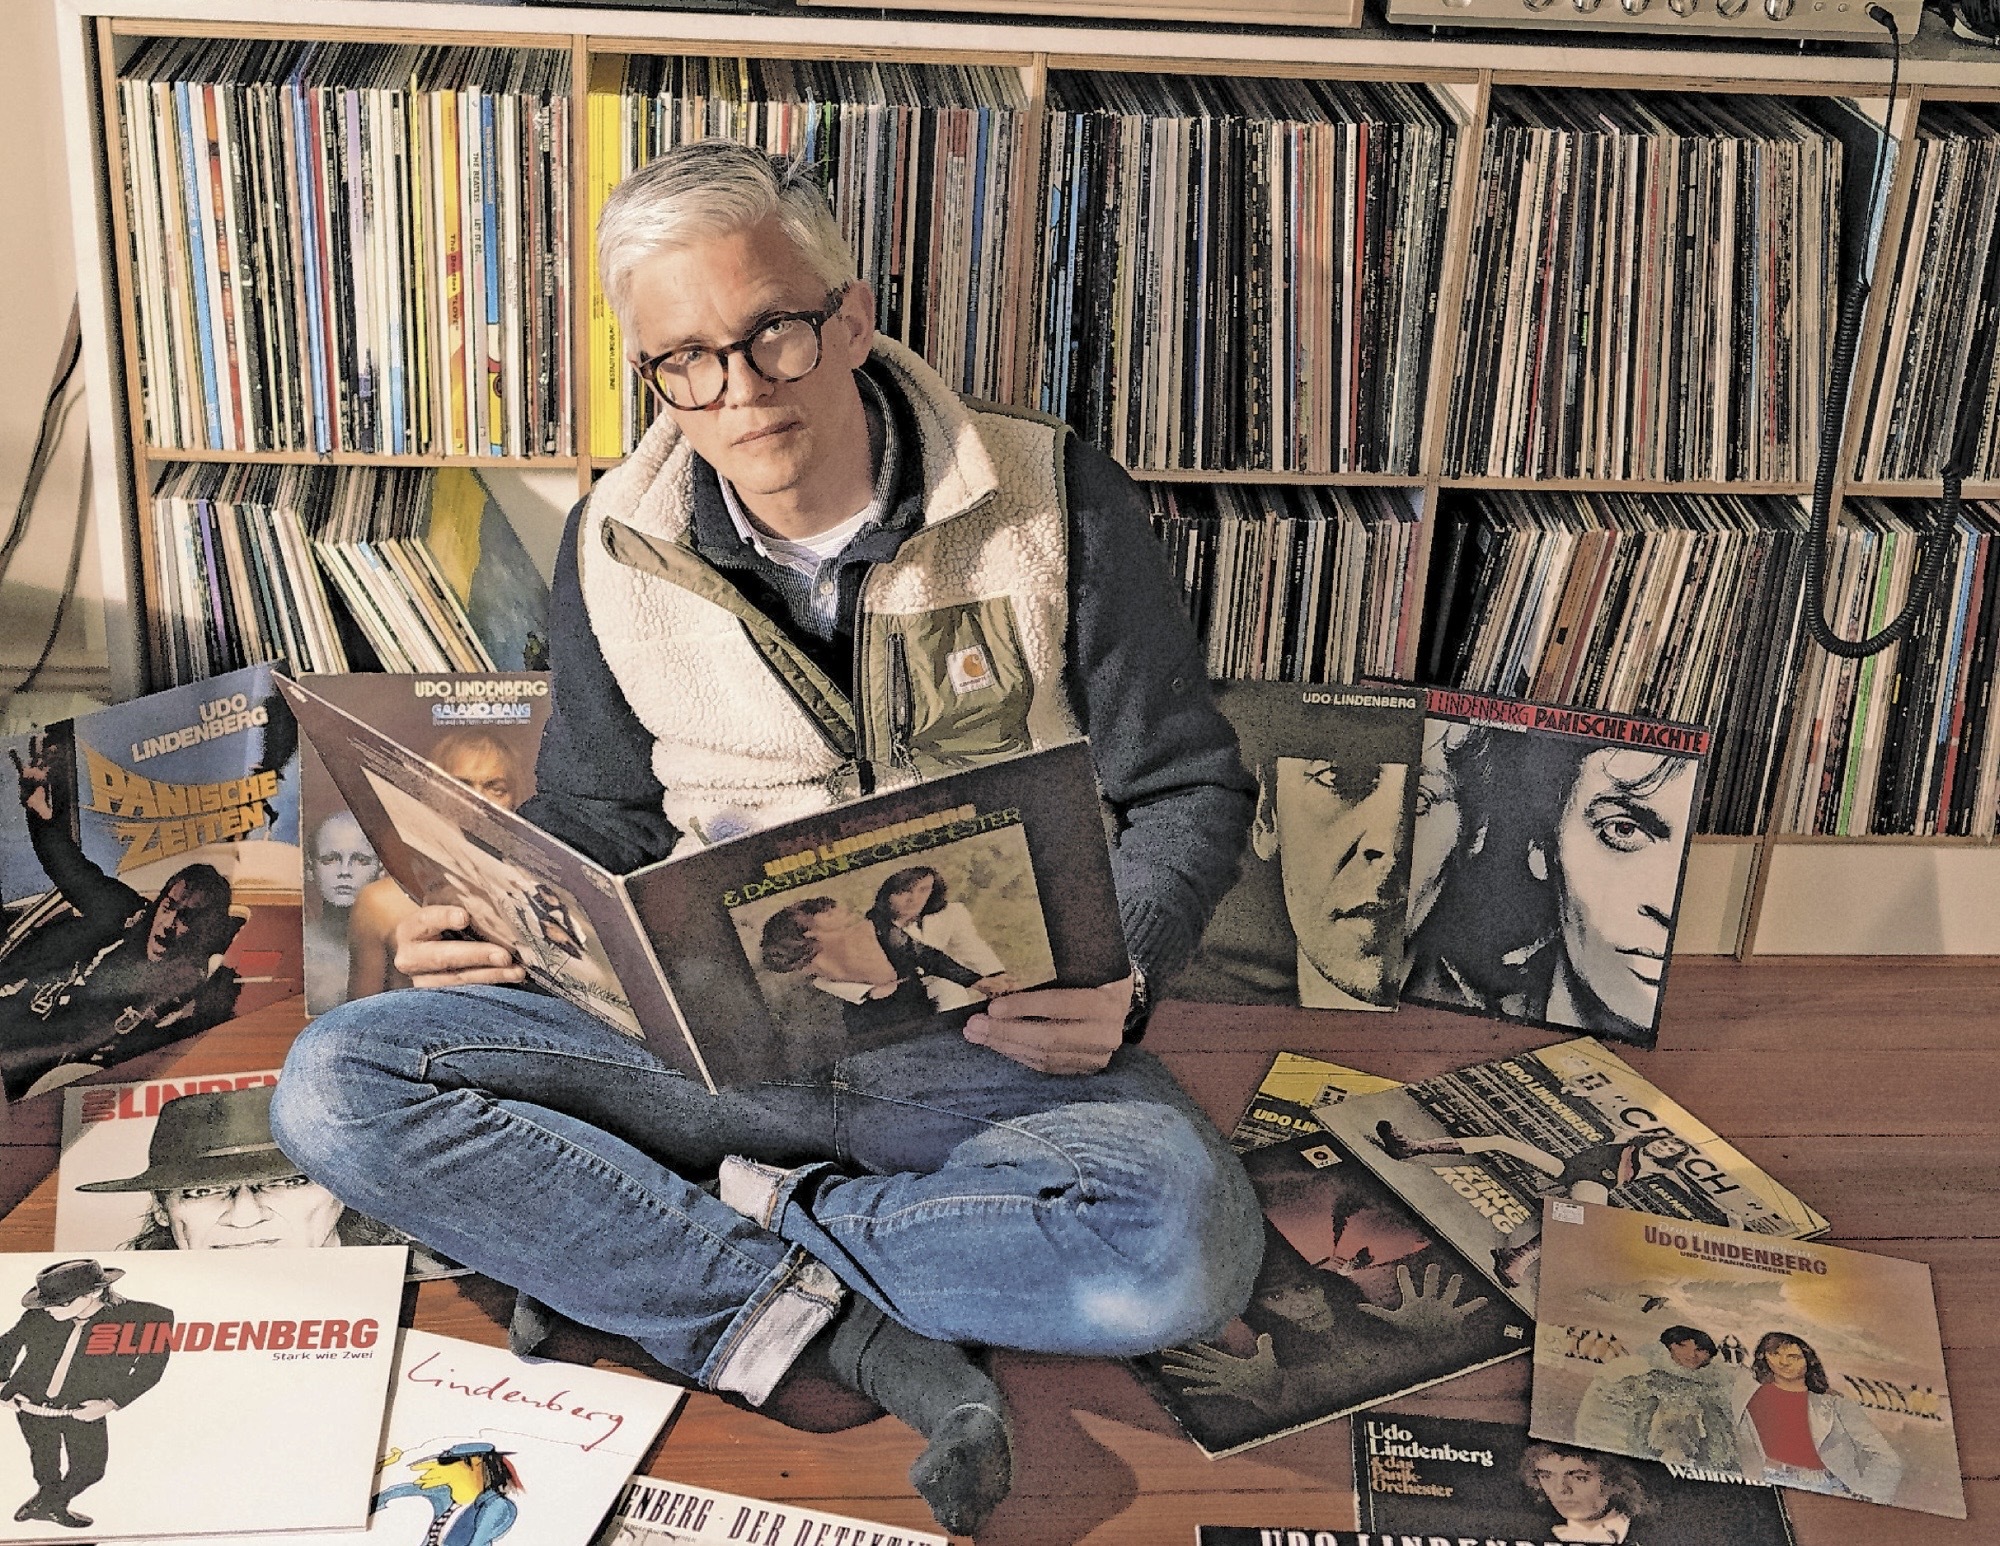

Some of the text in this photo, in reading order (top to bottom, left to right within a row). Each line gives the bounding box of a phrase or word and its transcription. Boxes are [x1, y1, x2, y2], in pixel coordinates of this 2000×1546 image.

[472, 152, 480, 168] THE
[473, 170, 481, 204] BEATLES
[474, 219, 482, 231] LET
[449, 233, 457, 252] The
[450, 255, 458, 292] Beatles
[414, 680, 549, 697] UDO LINDENBERG
[1302, 692, 1416, 710] UDO LINDENBERG
[199, 693, 247, 722] UDO
[492, 703, 531, 717] GANG
[1437, 691, 1529, 726] LINDENBERG
[1534, 708, 1626, 741] PANISCHE
[1630, 722, 1703, 753] NÄCHTE
[131, 706, 269, 763] LINDENBERG
[80, 742, 278, 818] PANISCHE
[109, 801, 265, 874] ZEITEN
[1253, 1108, 1291, 1127] UDO
[1501, 1061, 1605, 1143] UDO LINDENBERG
[1430, 1166, 1514, 1234] KONG
[1451, 1166, 1525, 1223] KING
[1643, 1225, 1828, 1276] UDO LINDENBERG
[1680, 1251, 1699, 1260] UND
[1701, 1254, 1718, 1263] DAS
[85, 1318, 379, 1355] UDO LINDENBERG
[272, 1350, 373, 1361] Stark wie Zwei
[407, 1352, 624, 1452] Lindenberg
[1367, 1421, 1413, 1441] Udo
[1369, 1437, 1494, 1467] Lindenberg
[1372, 1479, 1454, 1498] Orchester
[617, 1483, 715, 1533] ENBERG
[727, 1506, 785, 1546] DER
